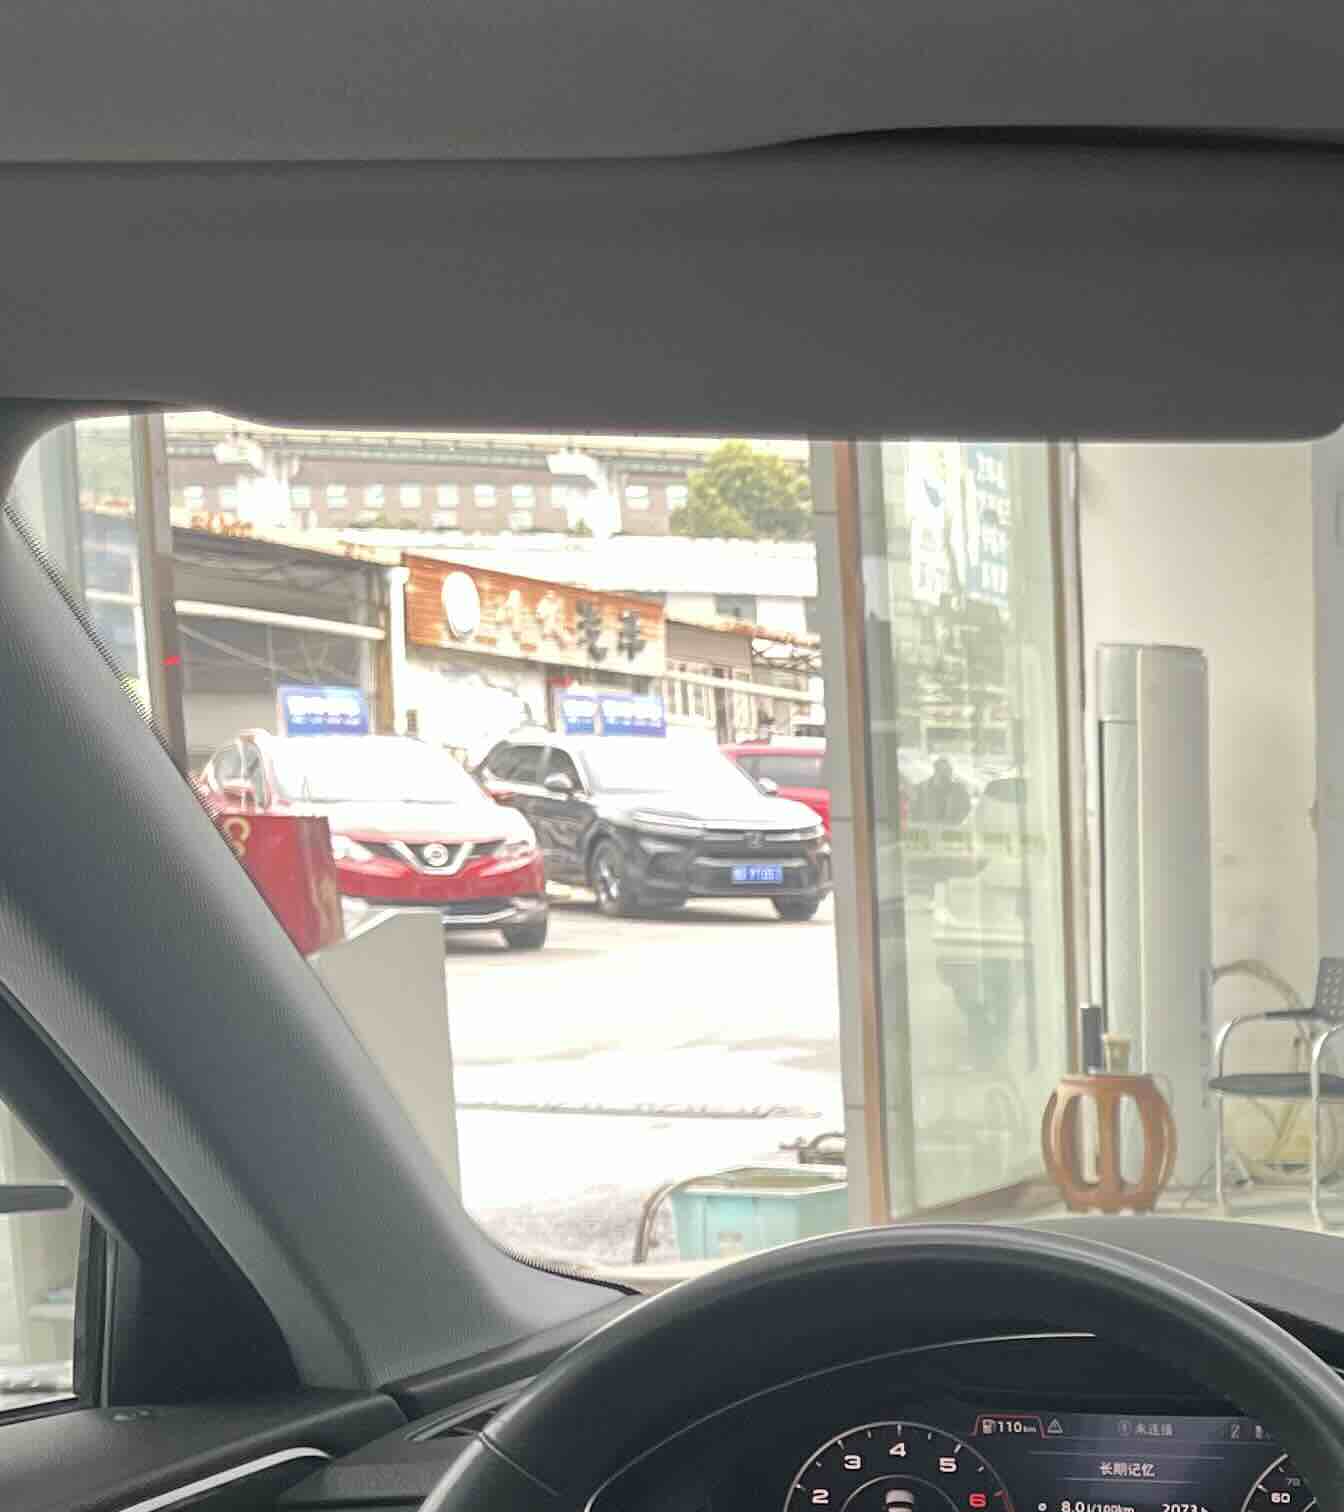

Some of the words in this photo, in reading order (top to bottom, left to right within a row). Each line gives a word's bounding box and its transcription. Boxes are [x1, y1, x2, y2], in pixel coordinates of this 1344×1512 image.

[889, 1442, 907, 1458] 4
[843, 1455, 862, 1470] 3
[939, 1457, 957, 1473] 5
[1099, 1461, 1156, 1478] 长期记忆
[811, 1489, 829, 1504] 2
[968, 1493, 987, 1508] 6
[1271, 1492, 1292, 1504] 60
